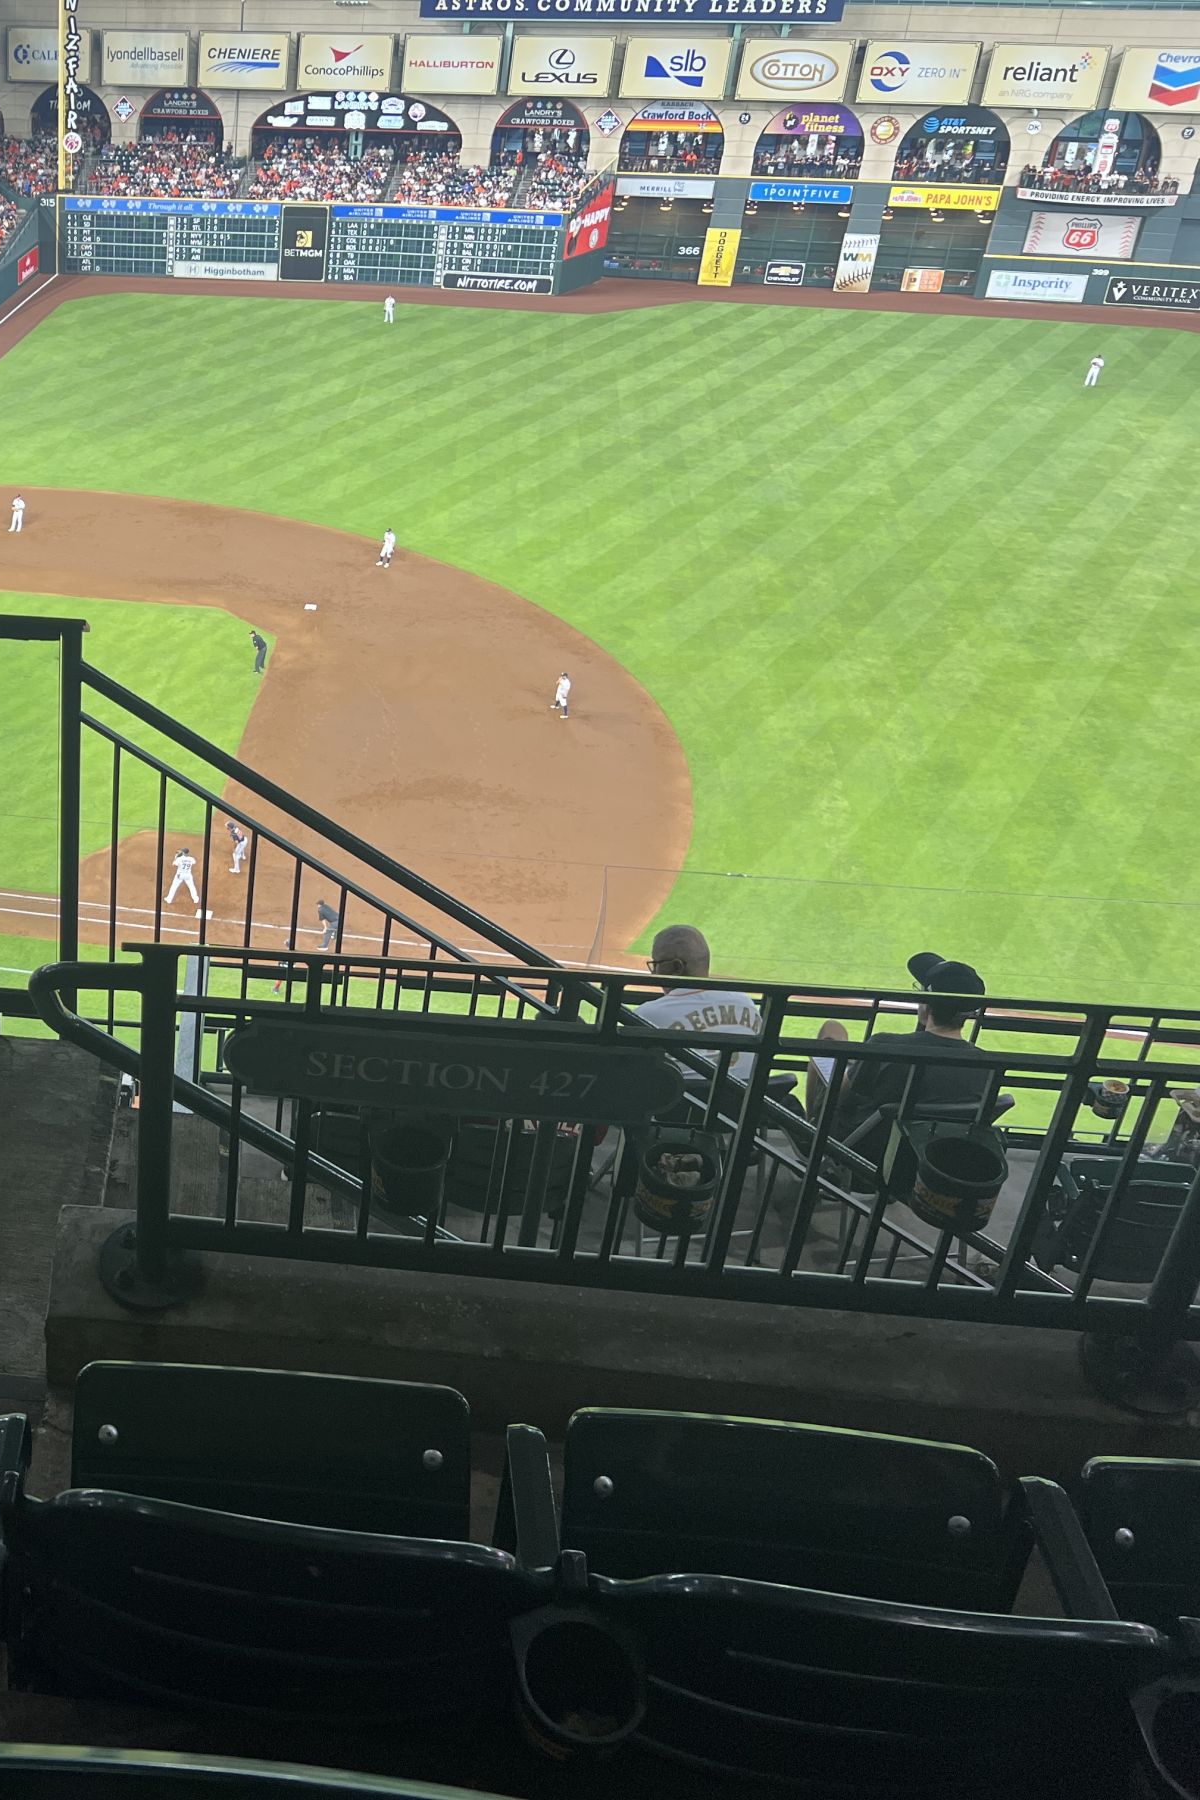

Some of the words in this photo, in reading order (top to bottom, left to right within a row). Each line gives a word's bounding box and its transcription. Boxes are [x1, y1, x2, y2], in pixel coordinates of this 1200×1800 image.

[538, 0, 695, 13] COMMUNITY
[709, 0, 828, 14] LEADERS
[106, 46, 184, 63] lyondellbasell
[207, 48, 281, 61] CHENIERE
[669, 49, 707, 73] slb
[304, 64, 385, 78] ConocoPhillips
[409, 60, 494, 69] HALLIBURTON
[761, 59, 826, 82] COTTON
[521, 72, 598, 84] LEXUS
[869, 66, 911, 77] OXY
[916, 67, 946, 78] ZERO
[1002, 61, 1079, 83] reliant
[65, 57, 80, 130] FAIR
[524, 109, 563, 117] LANDRY'S
[641, 109, 684, 121] Crawford
[688, 110, 713, 121] Bock
[801, 112, 841, 125] planet
[511, 117, 551, 126] CRAWFORD
[552, 118, 576, 127] BOXES
[804, 122, 846, 134] fitness
[940, 117, 967, 127] AT&T
[937, 126, 996, 136] SPORTSNET
[639, 185, 672, 193] MERRILL
[40, 198, 56, 207] 315
[924, 193, 952, 205] PAPA
[953, 194, 993, 207] JOHN'S
[1029, 190, 1070, 202] PROVIDING
[1103, 195, 1145, 205] IMPROVING
[1070, 221, 1099, 230] PHILLIPS
[1068, 231, 1093, 245] 66
[284, 248, 323, 258] BETMGM
[677, 246, 701, 256] 366
[712, 231, 728, 279] DOGGETT
[204, 266, 265, 276] Higginbotham
[456, 275, 538, 293] NITTOTIRE.COM
[1011, 275, 1073, 291] Insperity
[1131, 284, 1200, 300] VERITEX
[1133, 296, 1174, 304] COMMUNITY
[306, 1050, 511, 1094] SECTION
[528, 1069, 598, 1099] 427
